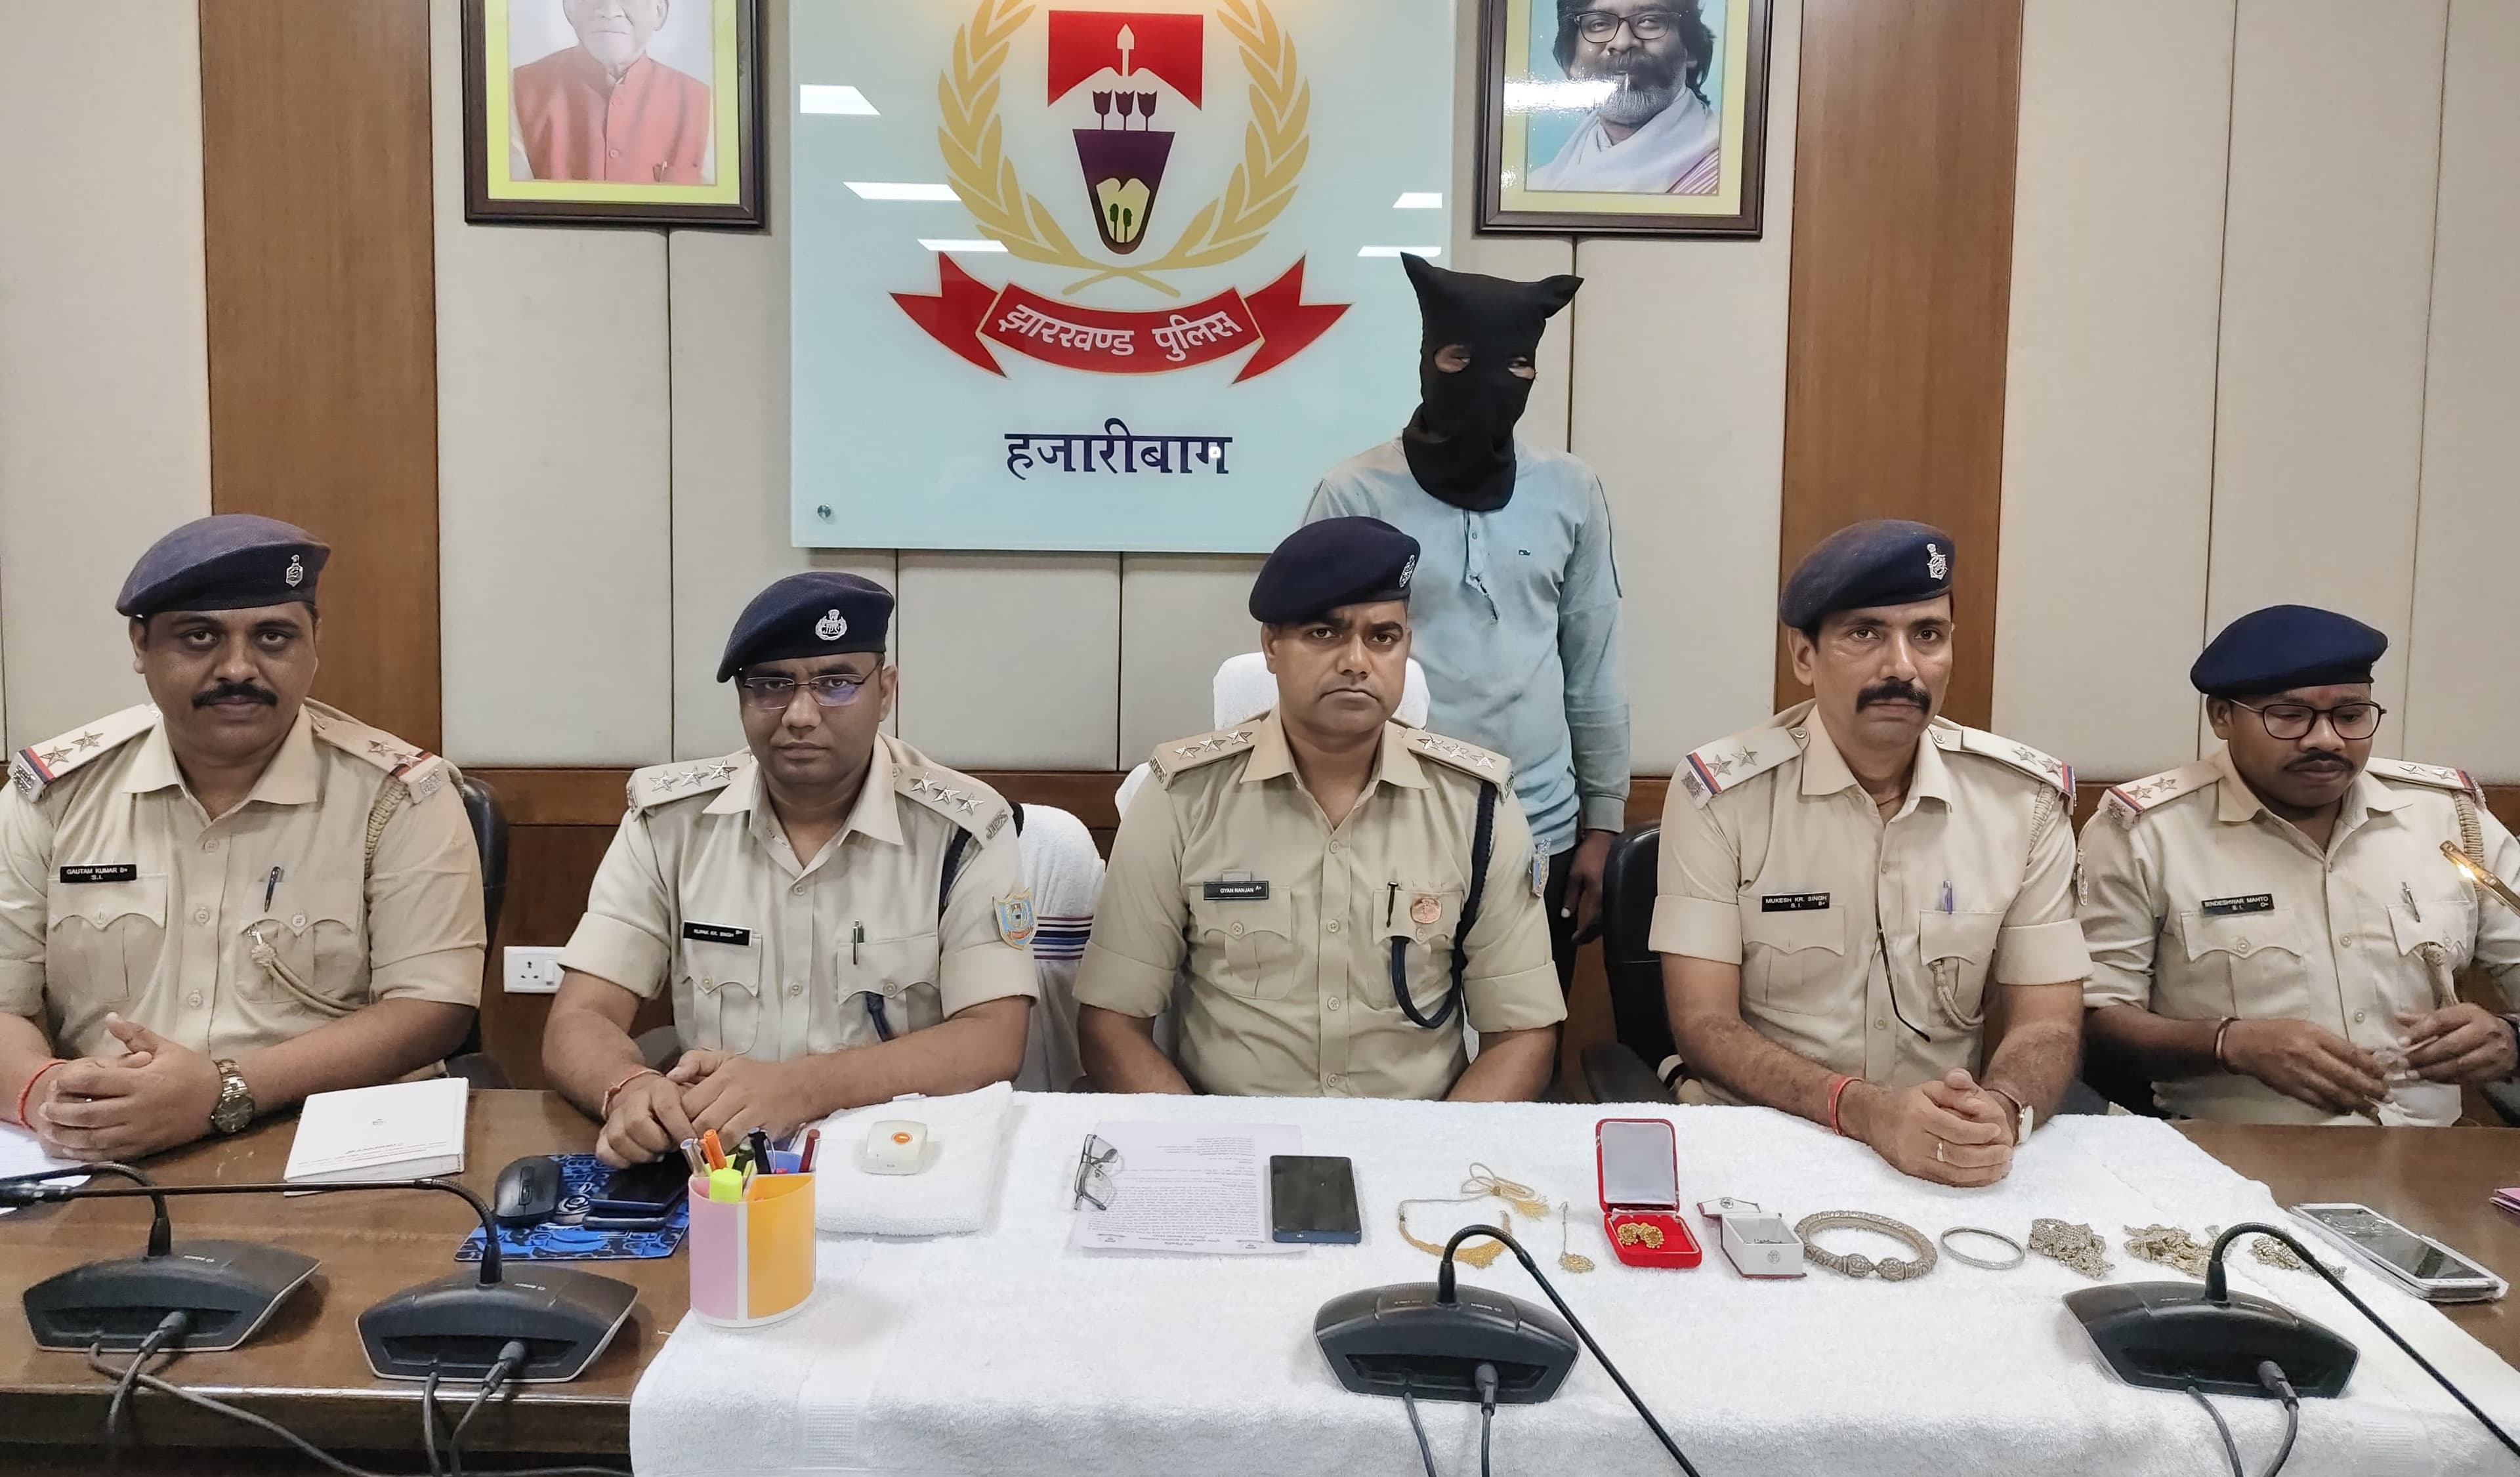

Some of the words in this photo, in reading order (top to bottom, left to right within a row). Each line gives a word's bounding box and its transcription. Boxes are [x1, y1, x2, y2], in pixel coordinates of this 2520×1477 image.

[998, 303, 1135, 356] झारखण्ड
[1152, 310, 1243, 362] पुलिस
[1004, 417, 1233, 480] हजारीबाग
